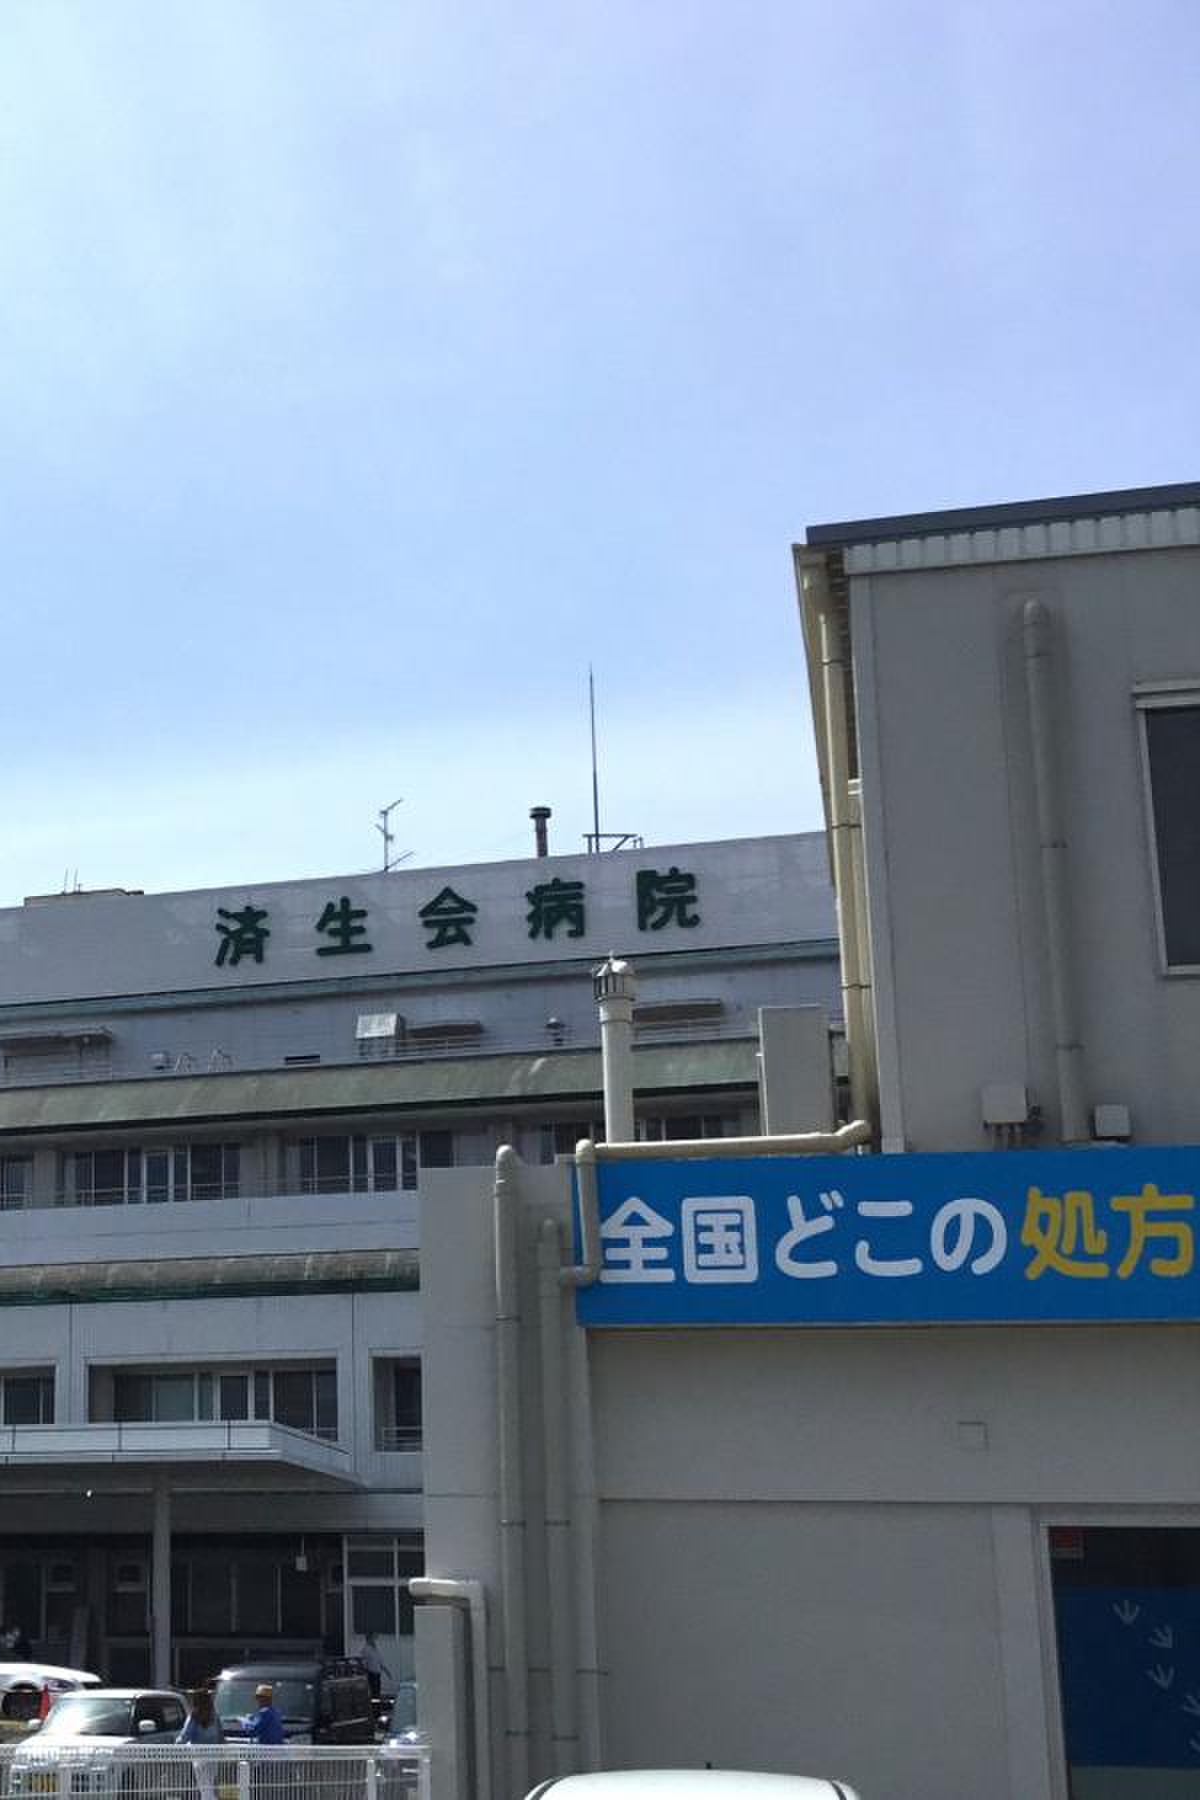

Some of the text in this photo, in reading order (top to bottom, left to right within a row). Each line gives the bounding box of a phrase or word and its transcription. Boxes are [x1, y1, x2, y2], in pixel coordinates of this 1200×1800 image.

[215, 866, 701, 967] 済生会病院
[600, 1183, 1195, 1284] 全国どこの処方
